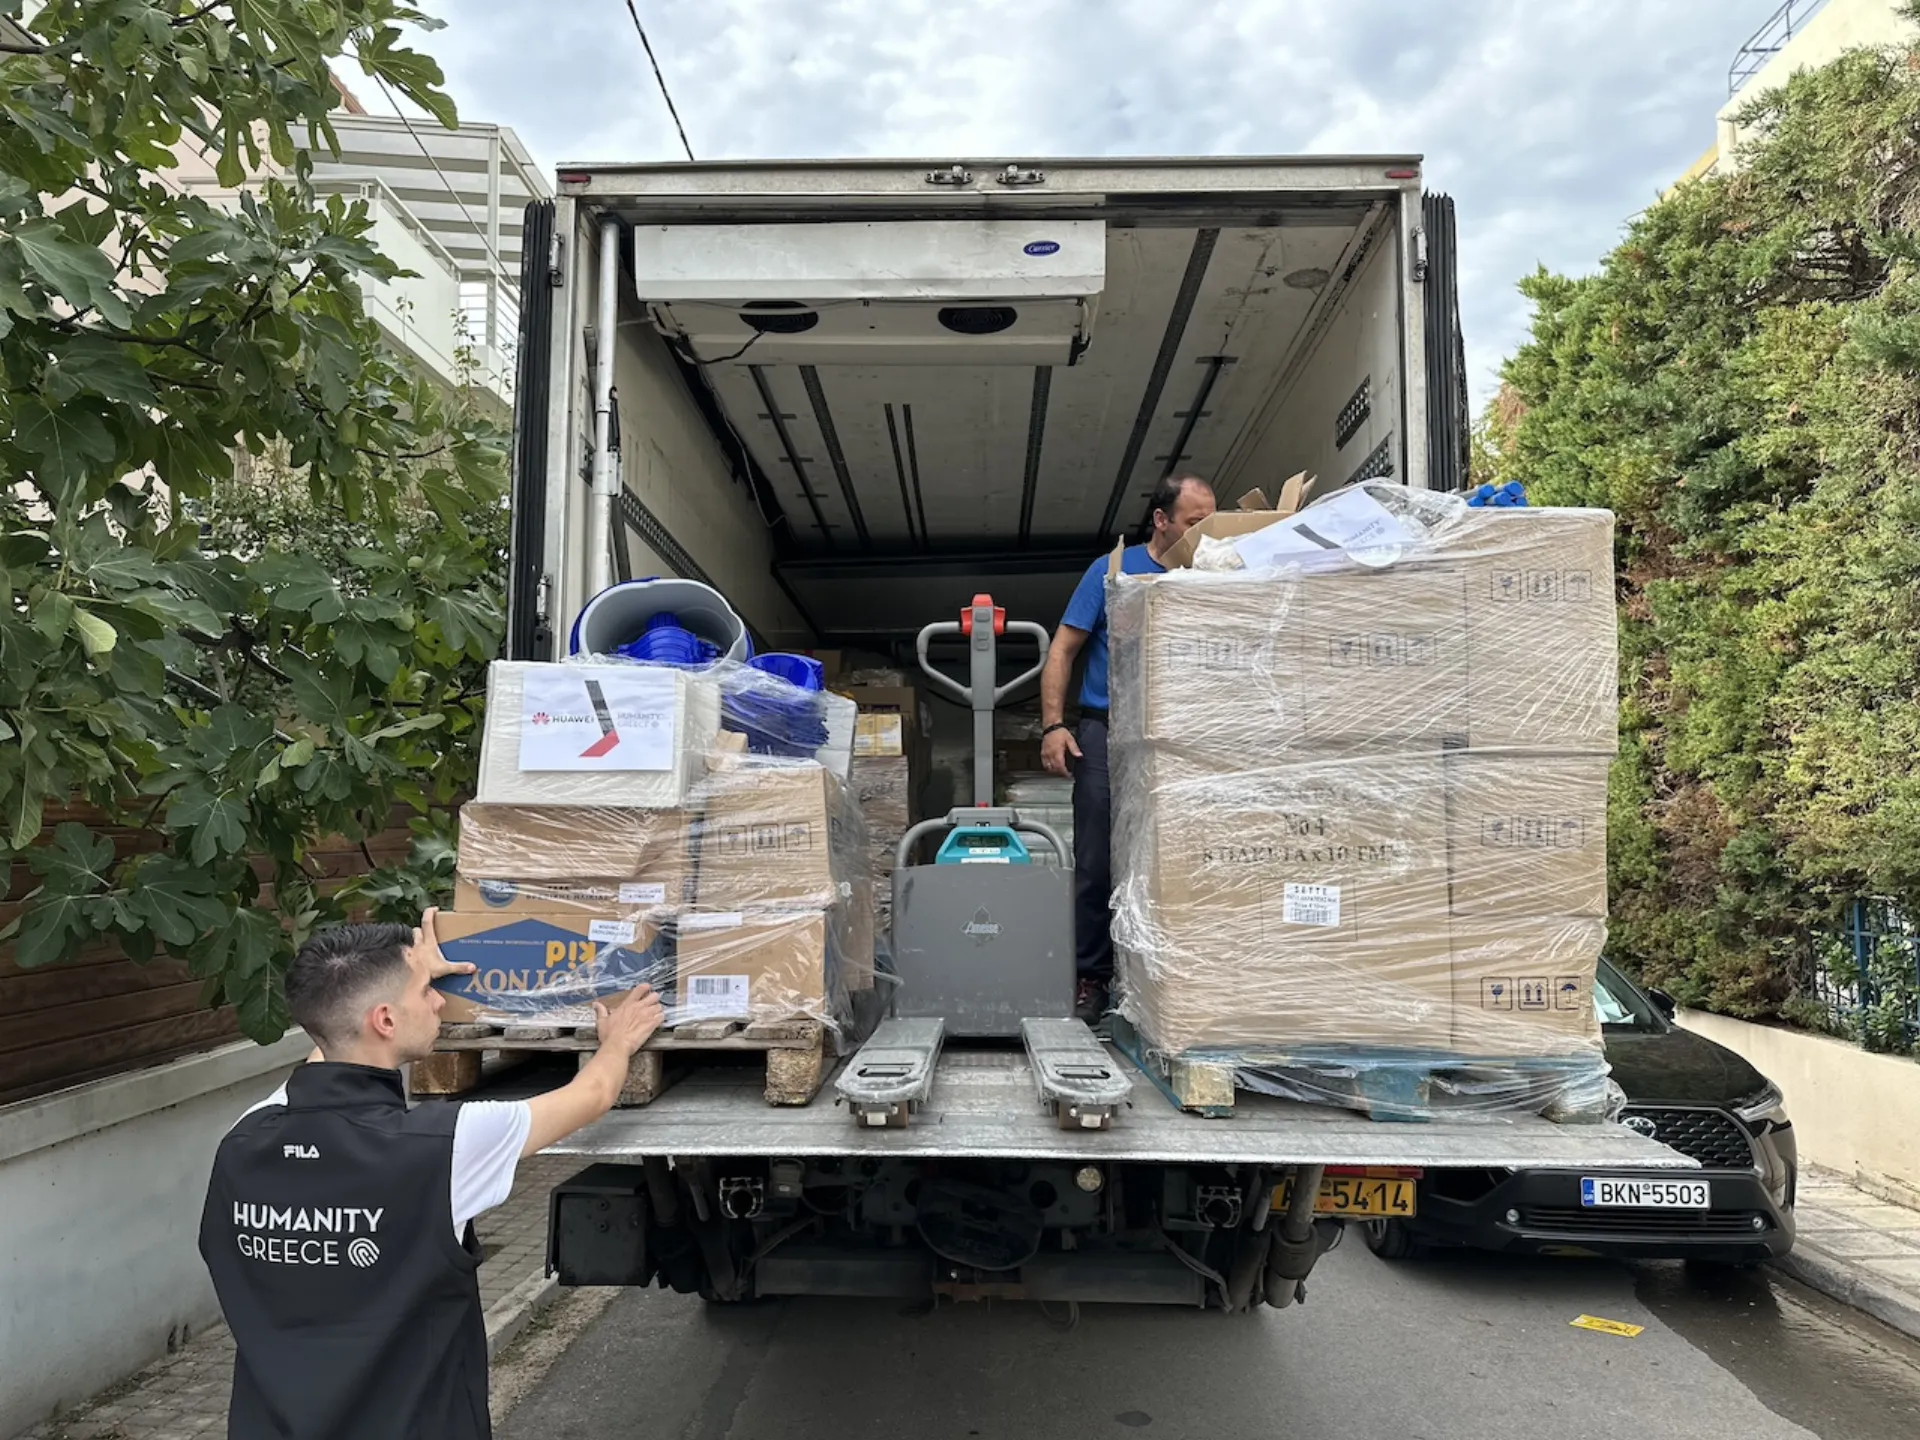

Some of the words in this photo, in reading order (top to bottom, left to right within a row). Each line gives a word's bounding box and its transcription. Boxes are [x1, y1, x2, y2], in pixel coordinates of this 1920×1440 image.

[552, 715, 595, 724] HUAWEI
[545, 940, 597, 969] kid
[283, 1145, 320, 1159] FILA
[1601, 1183, 1706, 1205] BKN-5503
[233, 1201, 384, 1233] HUMANITY
[237, 1233, 340, 1265] GREECE
